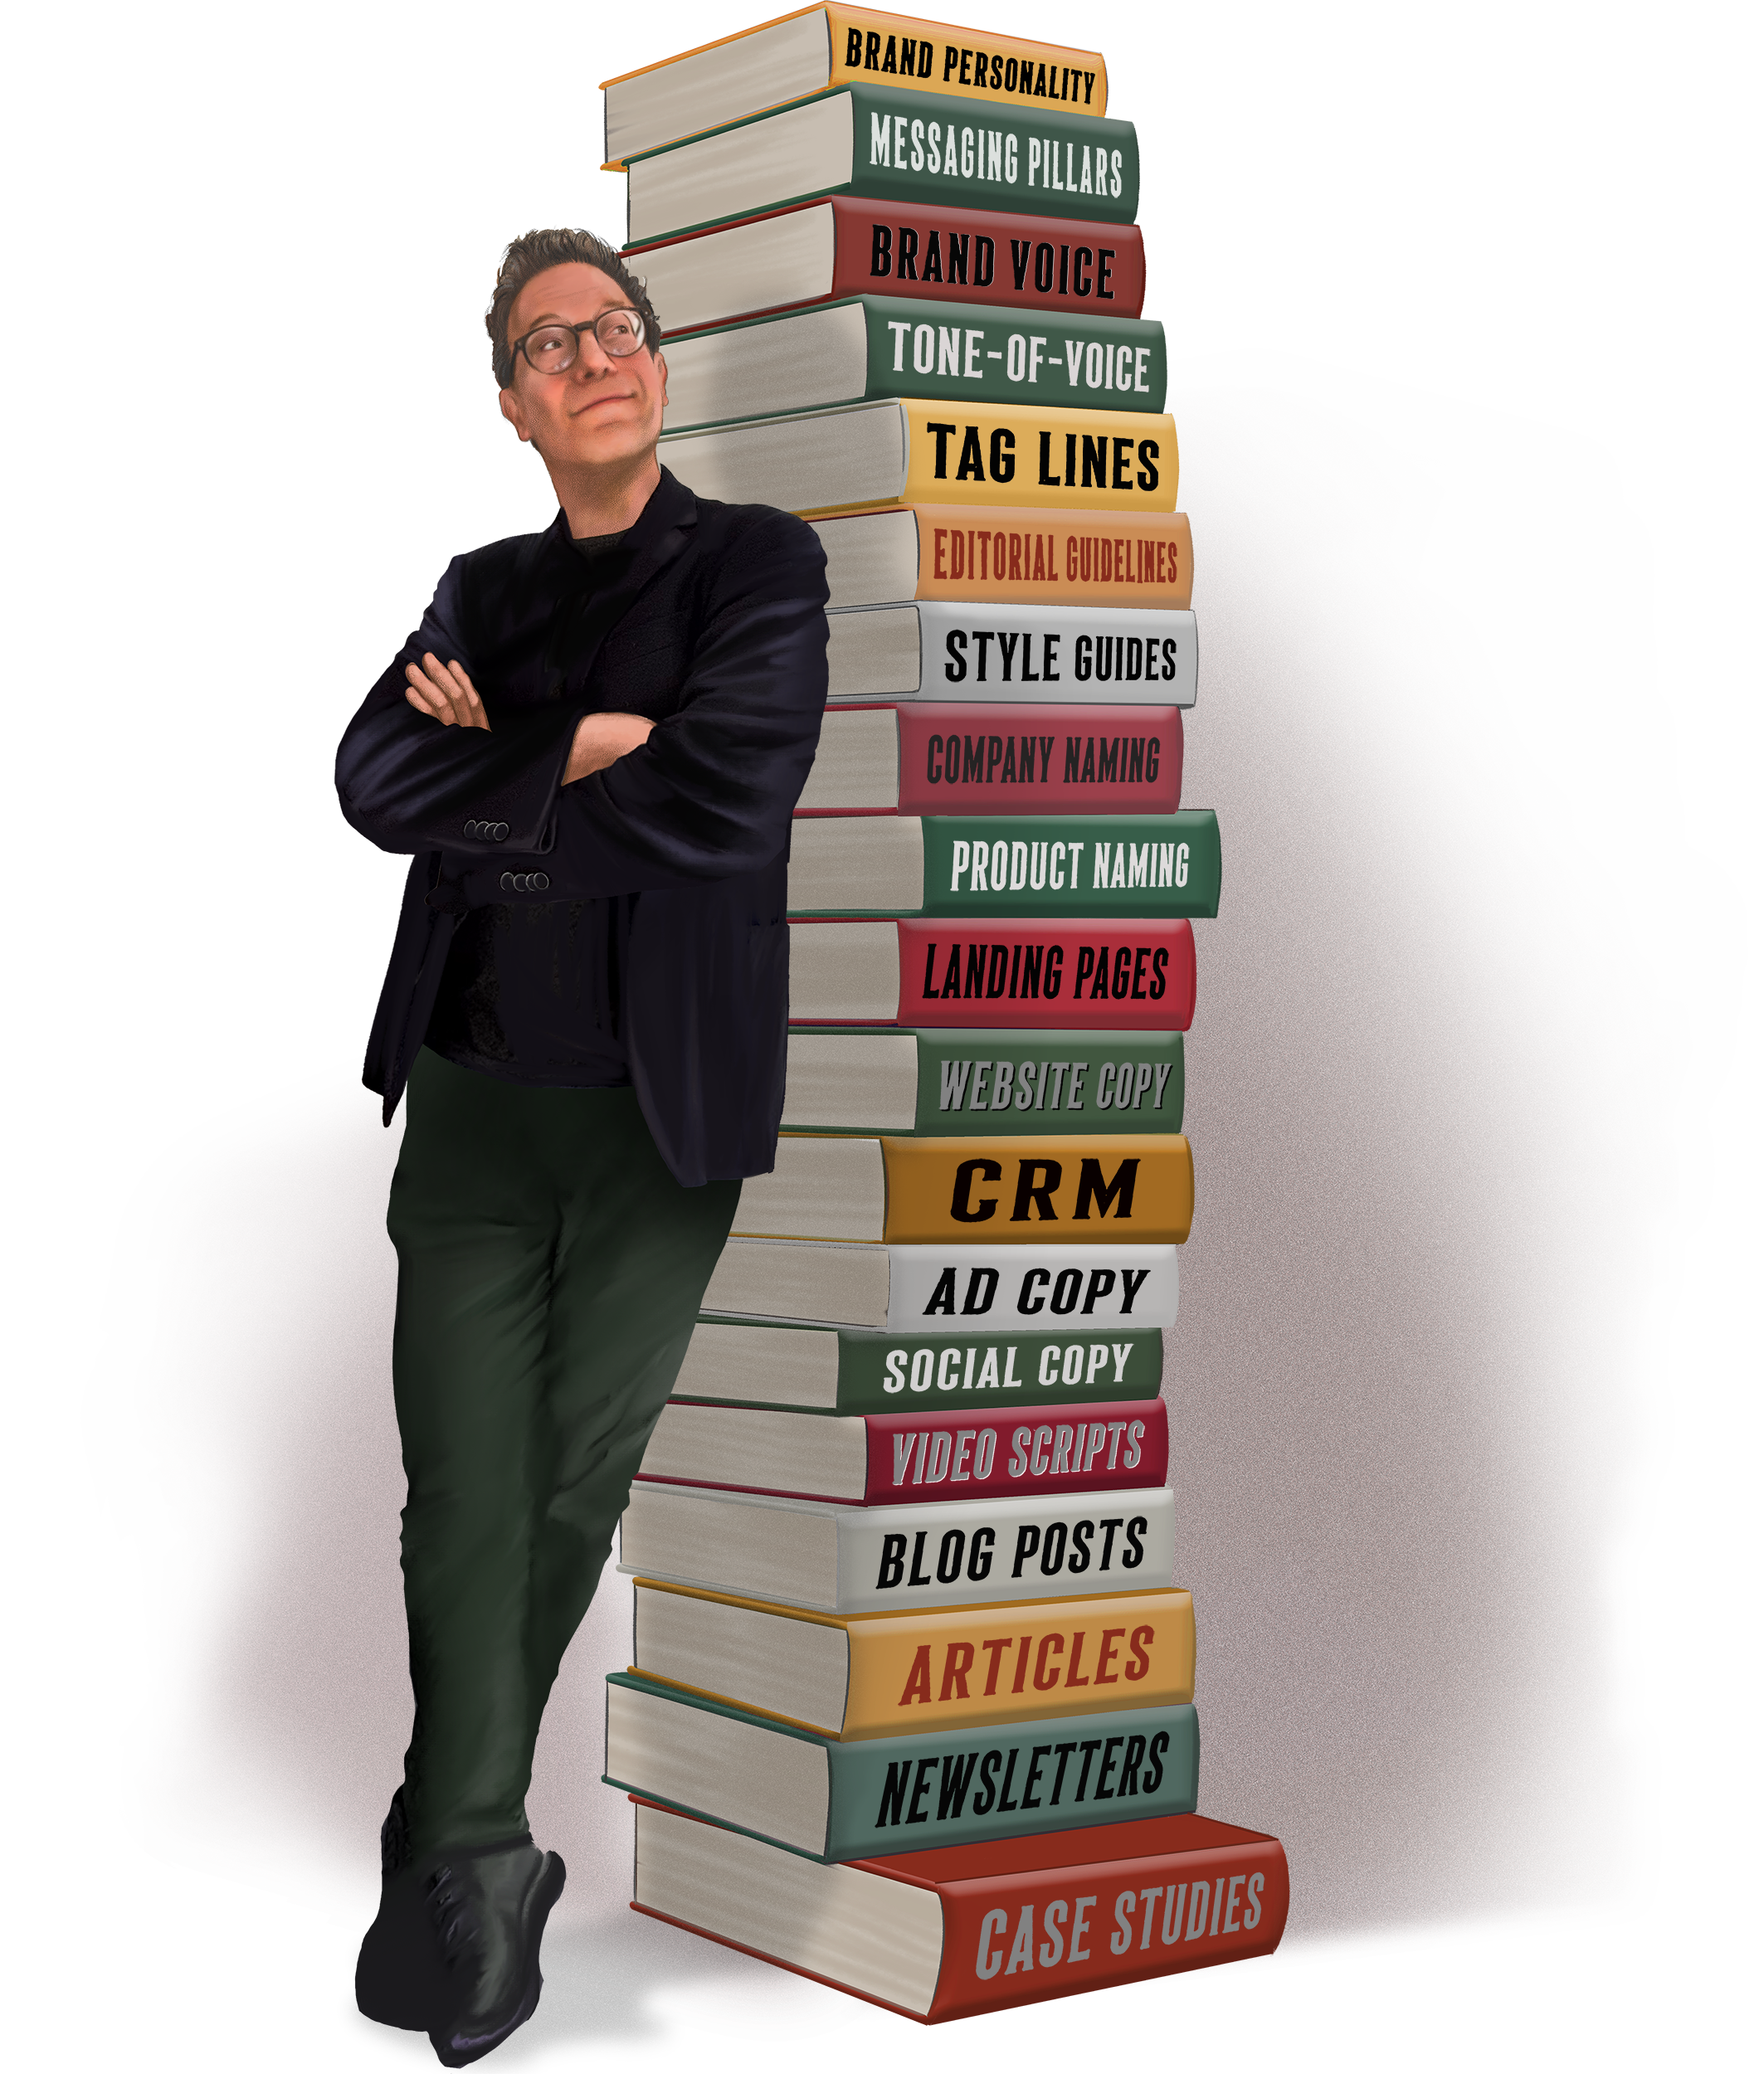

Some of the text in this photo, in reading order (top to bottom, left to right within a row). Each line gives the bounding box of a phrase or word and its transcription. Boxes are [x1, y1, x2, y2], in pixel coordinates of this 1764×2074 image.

[845, 28, 1096, 105] BRAND PERSONALITY
[870, 112, 1123, 199] MESSAGING PILLARS
[870, 224, 1115, 299] BRAND VOICE
[888, 320, 1151, 393] TONE-OF-VOICE
[927, 422, 1160, 491] TAG LINES
[933, 528, 1177, 583] EDITORIAL GUIDELINES
[945, 629, 1177, 683] STYLE GUIDES
[926, 734, 1160, 784] COMPANY NAMING
[950, 840, 1189, 891] PRODUCT NAMING
[923, 943, 1169, 1000] LANDING PAGES
[939, 1060, 1172, 1110] WEBSITE COPY
[950, 1158, 1141, 1223] CRM
[923, 1268, 1151, 1315] AD COPY
[884, 1343, 1133, 1393] SOCIAL COPY
[891, 1419, 1146, 1486] VIDEO SCRIPTS
[875, 1516, 1148, 1589] BLOG POSTS
[898, 1624, 1155, 1706] ARTICLES
[875, 1731, 1170, 1828] NEWSLETTERS
[975, 1872, 1265, 1980] CASE STUDIES
